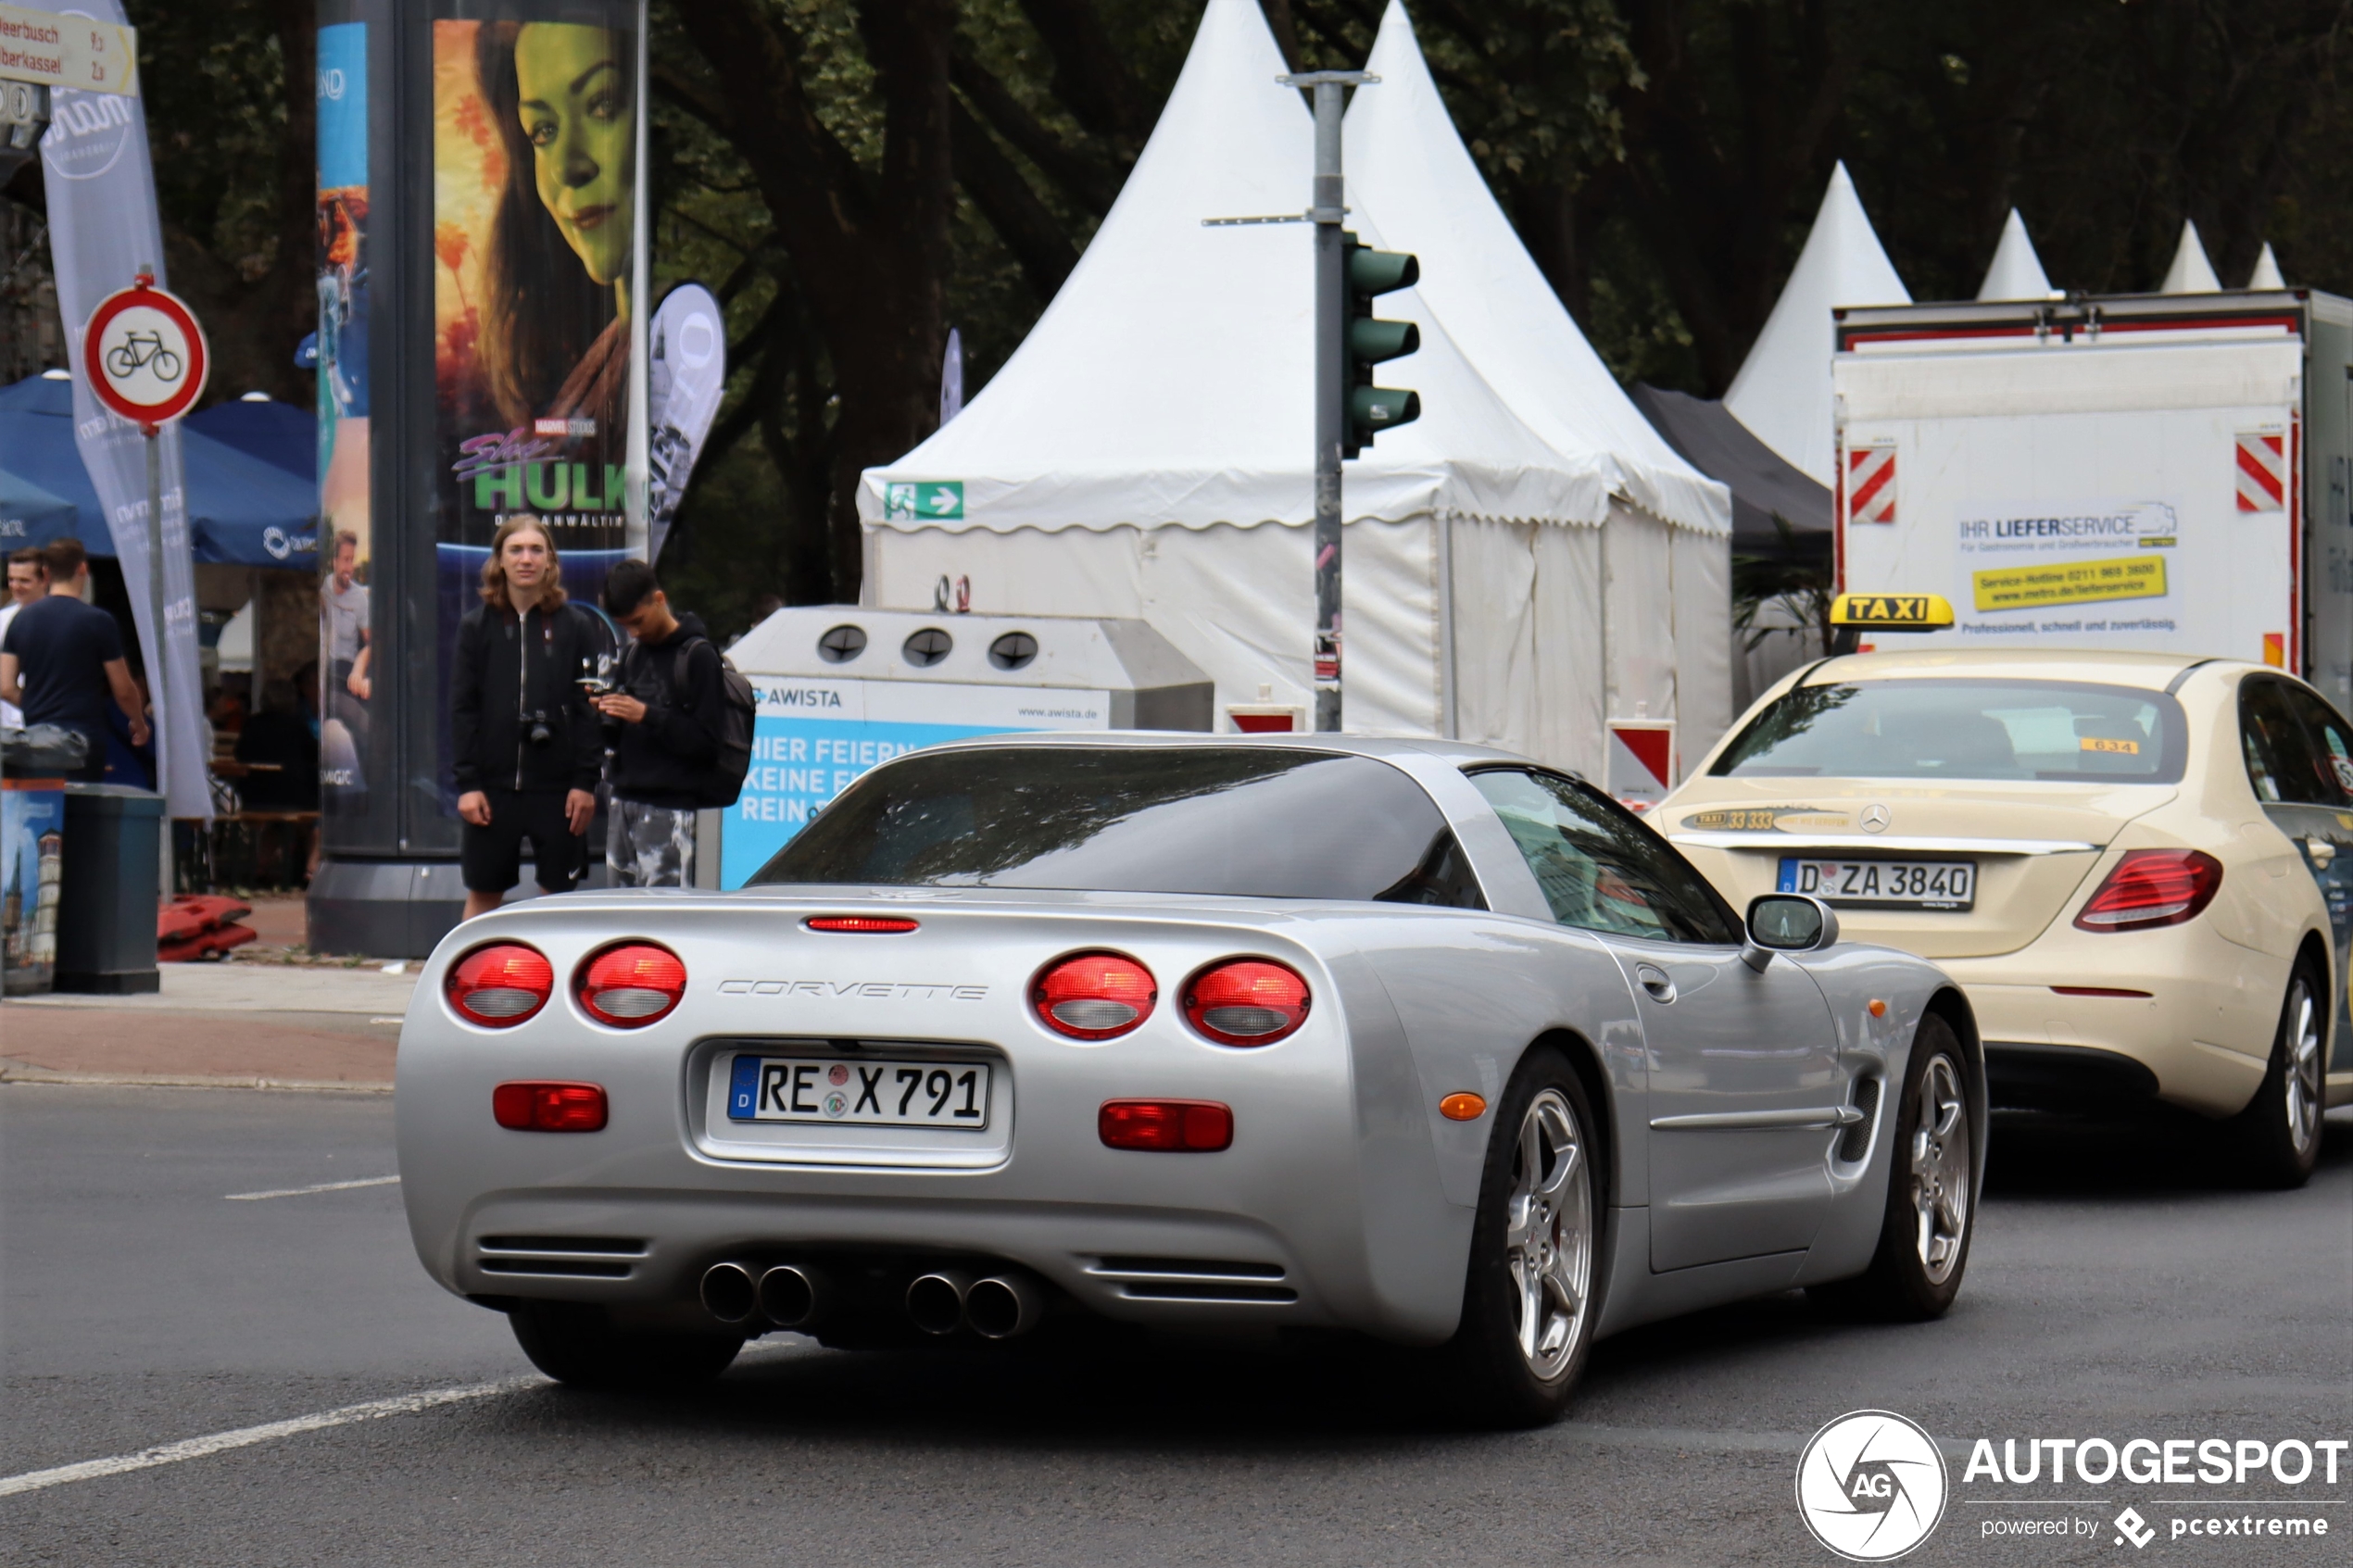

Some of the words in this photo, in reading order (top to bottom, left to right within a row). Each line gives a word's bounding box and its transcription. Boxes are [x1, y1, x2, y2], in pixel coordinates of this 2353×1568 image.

[0, 19, 58, 44] eerbusch
[0, 47, 61, 74] berkassel
[535, 420, 566, 434] MARVEL
[568, 420, 596, 435] STUDIOS
[474, 462, 628, 509] HULK
[1961, 521, 1989, 538] IHR
[1996, 516, 2134, 537] LIEFERSERVICE
[1979, 541, 2035, 552] Gastronomie
[2038, 540, 2056, 550] und
[1981, 571, 2064, 589] Service-Hotline
[1851, 599, 1925, 619] TAXI
[1962, 622, 2038, 636] Professionell,
[2041, 621, 2082, 633] schnell
[2085, 620, 2106, 632] und
[768, 688, 841, 708] AWISTA
[1018, 707, 1098, 720] www.awista.de
[750, 736, 806, 762] HIER
[2095, 741, 2132, 753] 634
[743, 767, 824, 793] KEINE
[742, 797, 806, 822] REIN
[1698, 814, 1723, 823] TAXI
[1729, 811, 1745, 829] 33
[1748, 811, 1773, 829] 333
[1800, 864, 1819, 895] D
[1841, 865, 1880, 896] ZA
[1889, 867, 1969, 897] 3840
[716, 979, 989, 1000] CORVETTE
[738, 1094, 749, 1108] D
[759, 1064, 820, 1112] RE
[853, 1067, 884, 1114] X
[896, 1069, 981, 1118] 791
